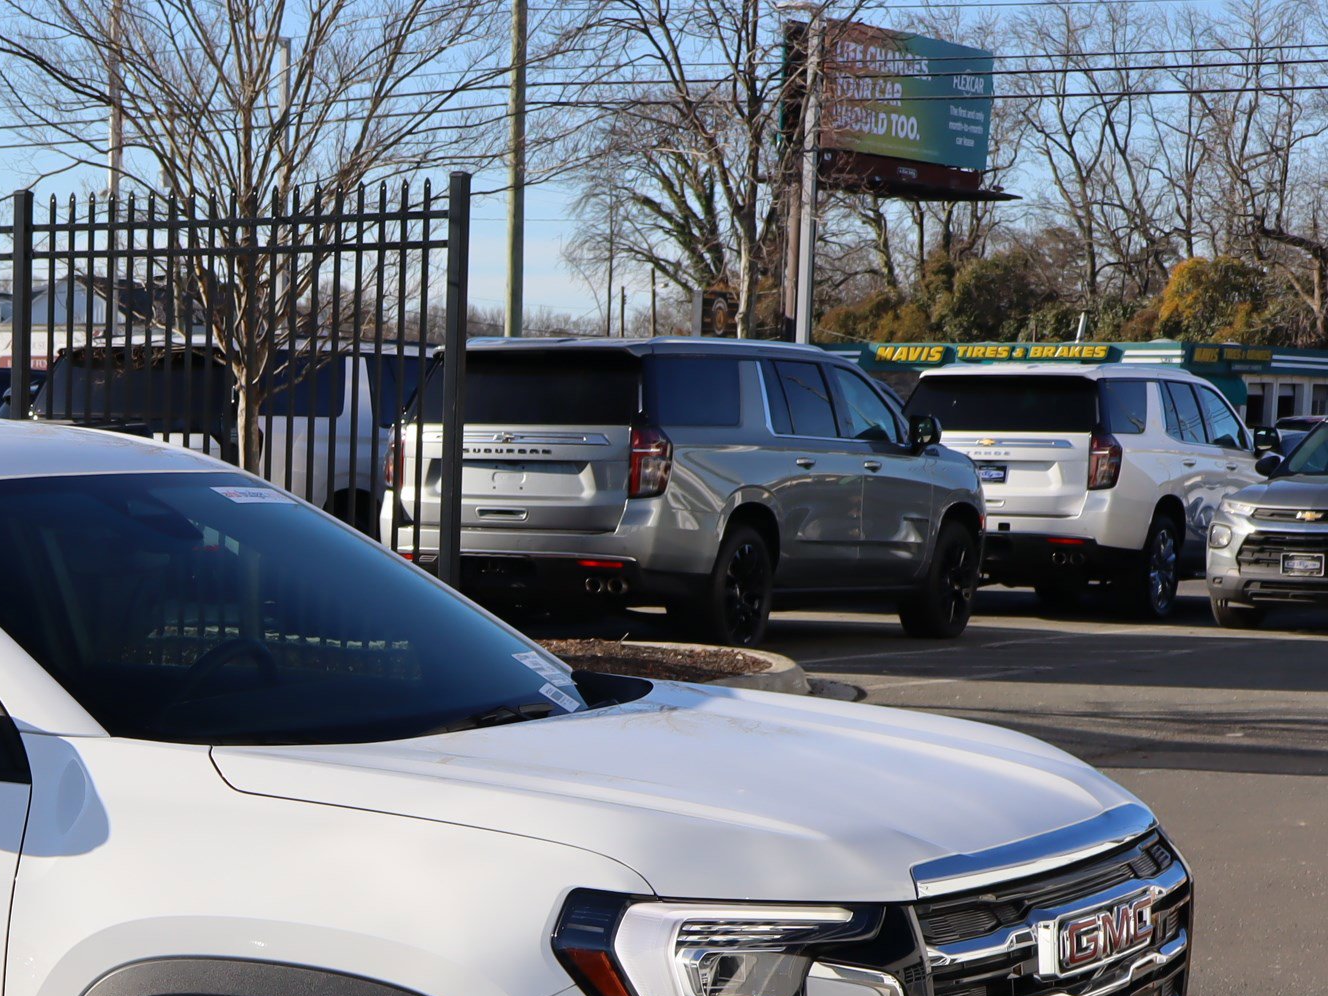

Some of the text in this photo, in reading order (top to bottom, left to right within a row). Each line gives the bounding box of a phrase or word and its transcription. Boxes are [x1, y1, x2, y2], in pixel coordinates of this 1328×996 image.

[875, 79, 902, 107] CAR
[891, 113, 920, 140] TOO.
[876, 346, 944, 361] MAVIS
[957, 346, 1009, 358] TIRES
[1030, 346, 1107, 358] BRAKES
[1063, 896, 1155, 966] GMC
